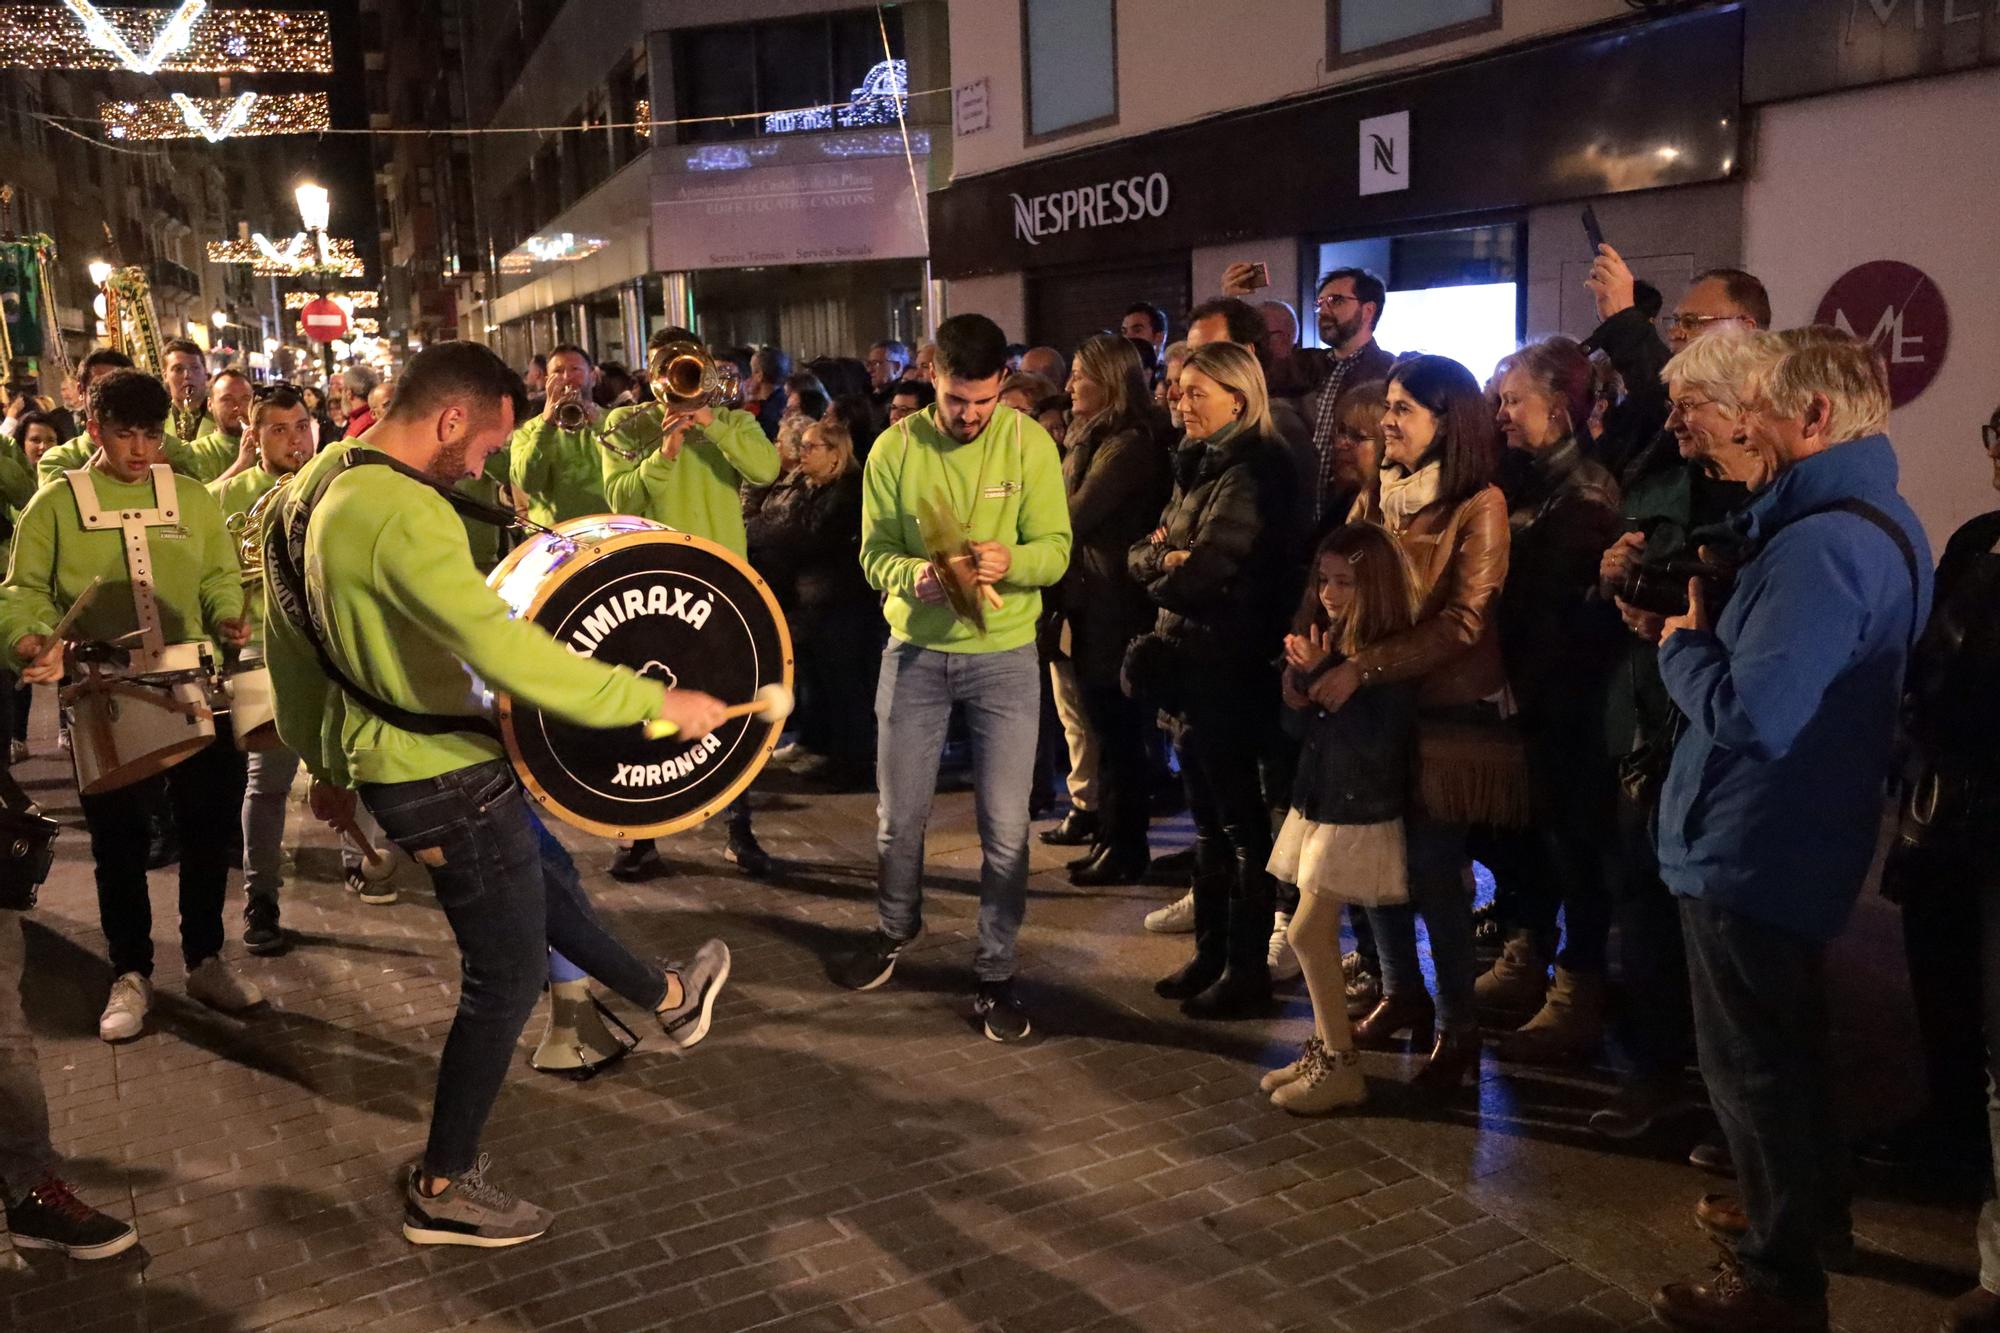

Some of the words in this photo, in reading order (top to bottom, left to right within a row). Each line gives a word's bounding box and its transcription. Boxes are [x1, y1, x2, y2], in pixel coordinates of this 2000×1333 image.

[1367, 134, 1400, 175] N
[810, 193, 875, 207] CANTONS
[1009, 172, 1169, 246] NESPRESSO
[796, 246, 832, 258] Serveis
[611, 732, 721, 787] XARANGA
